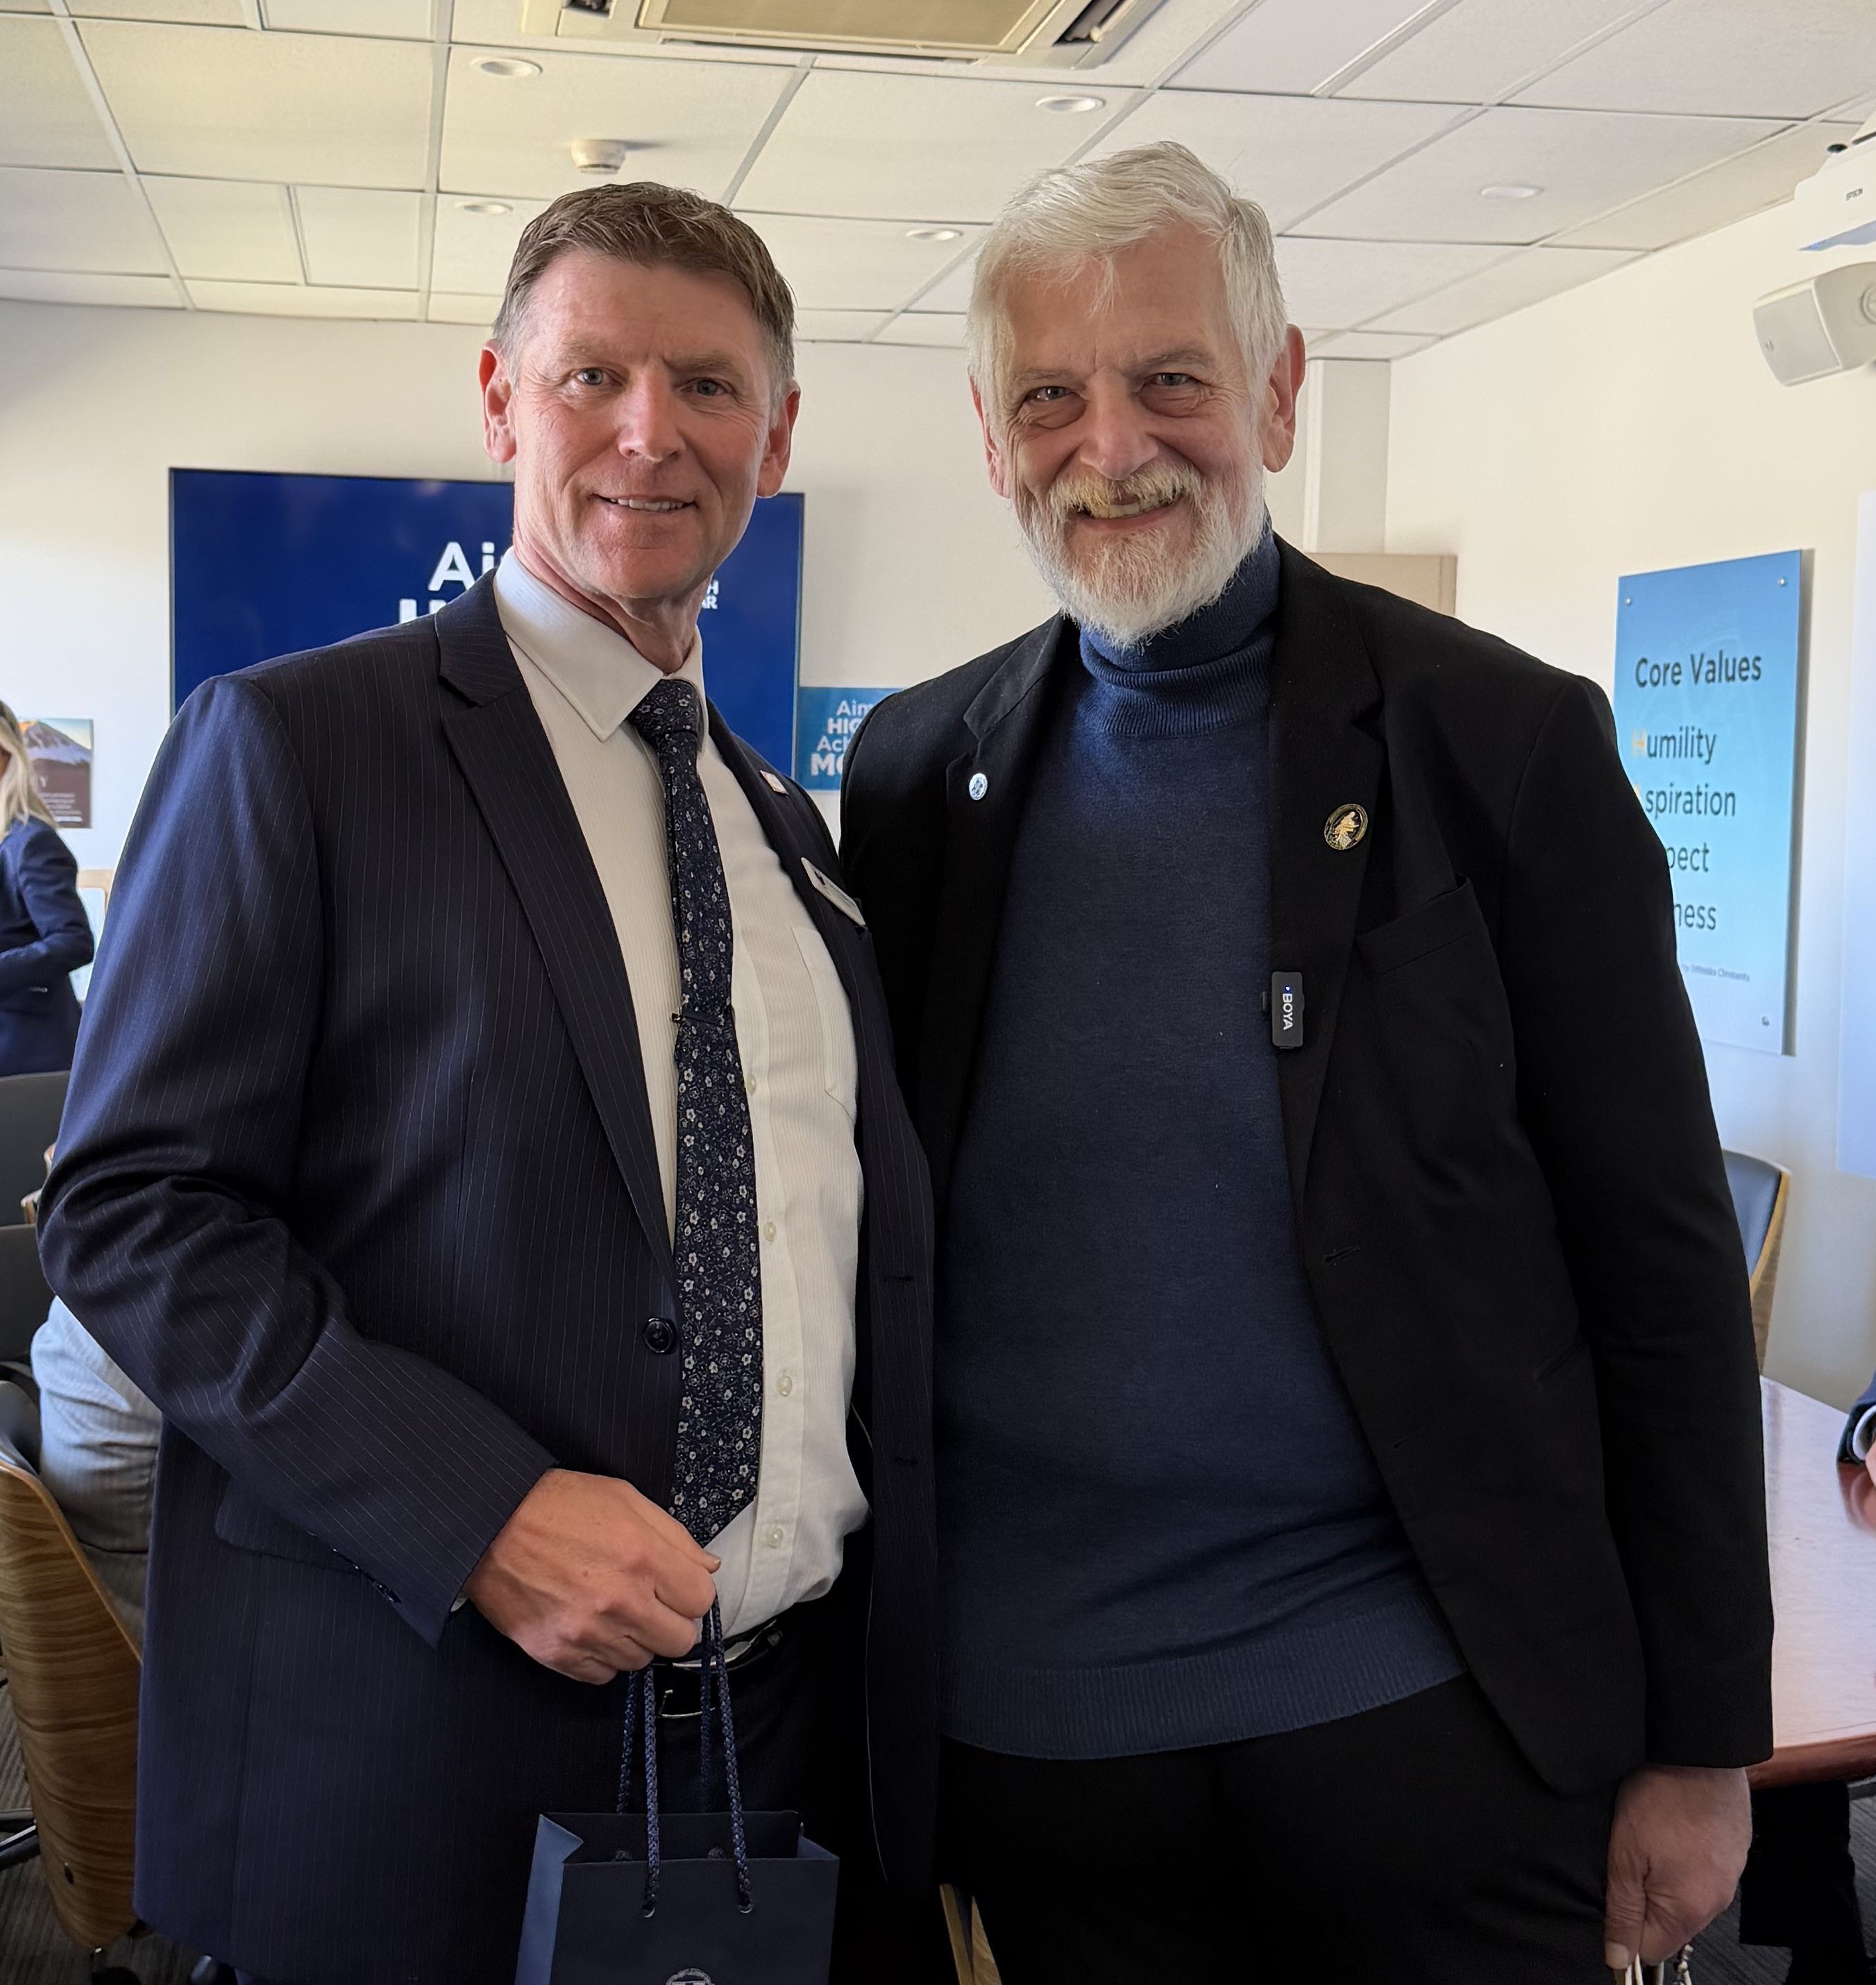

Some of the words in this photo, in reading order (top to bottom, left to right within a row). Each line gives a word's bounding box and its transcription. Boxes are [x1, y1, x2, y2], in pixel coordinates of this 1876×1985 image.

[427, 541, 496, 591] Ai
[1635, 658, 1682, 689] Core
[1690, 650, 1762, 685] Values
[1632, 725, 1717, 765] Humility
[1283, 993, 1293, 1030] BOYA
